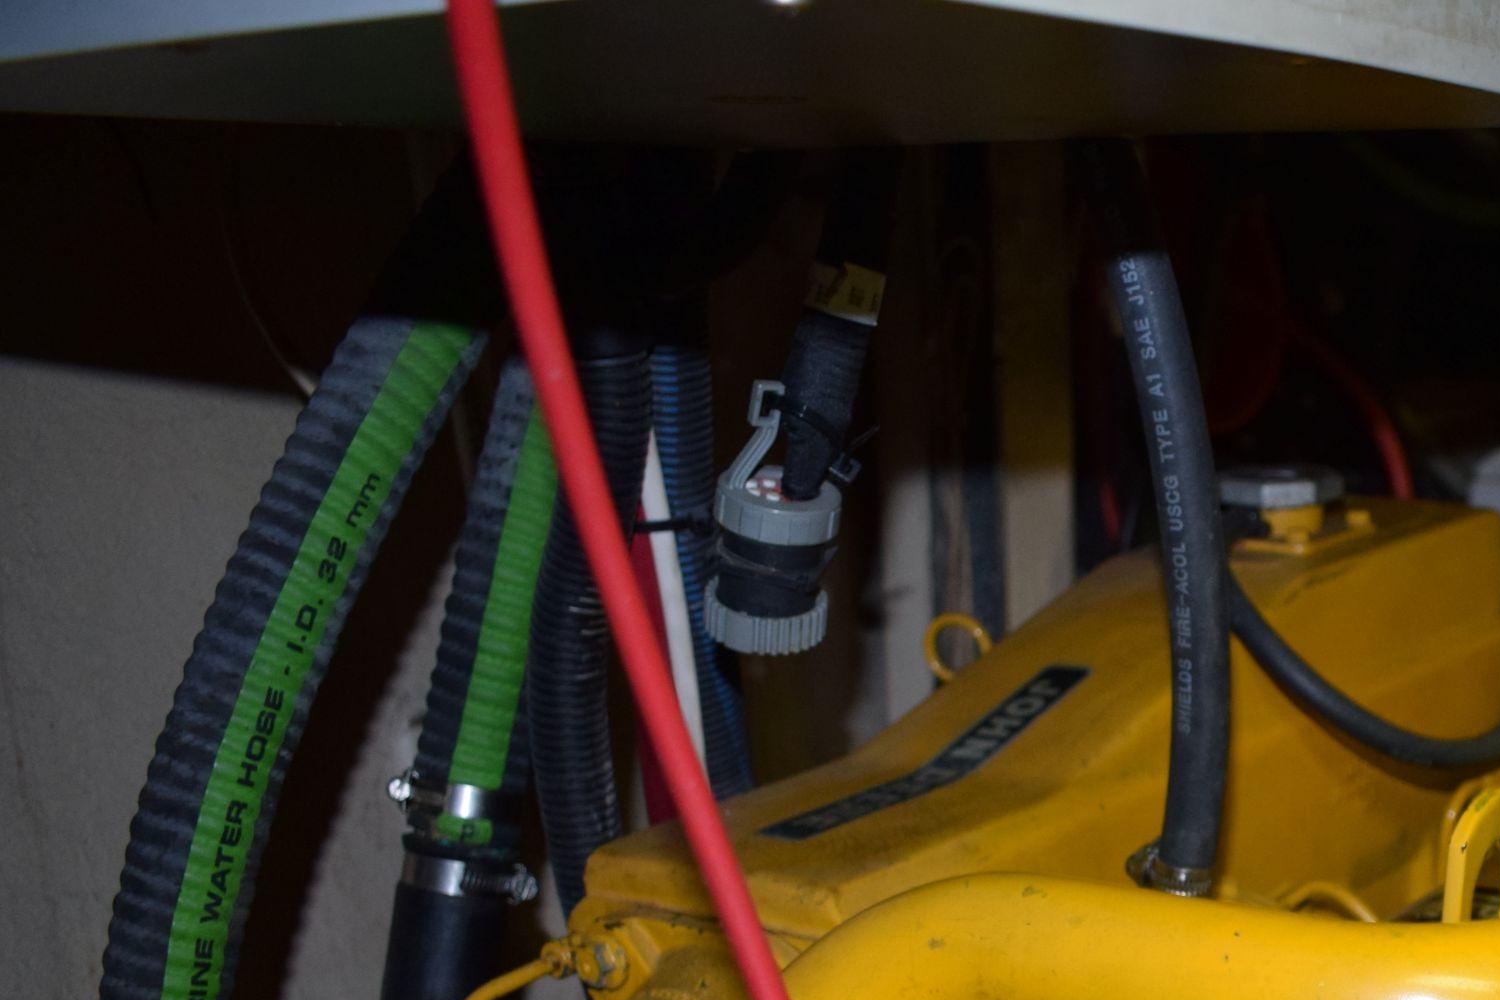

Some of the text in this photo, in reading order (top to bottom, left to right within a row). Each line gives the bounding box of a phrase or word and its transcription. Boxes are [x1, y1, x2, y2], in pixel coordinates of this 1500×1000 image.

[201, 800, 248, 923] WATER
[236, 686, 284, 788] HOSE
[287, 598, 323, 654] I.D.
[318, 536, 348, 584] 32
[346, 472, 381, 527] mm
[949, 677, 1061, 760] JOHN
[1119, 256, 1194, 734] SHIELDS FIRE-ACOL USCG TYPE A1 SAE J152
